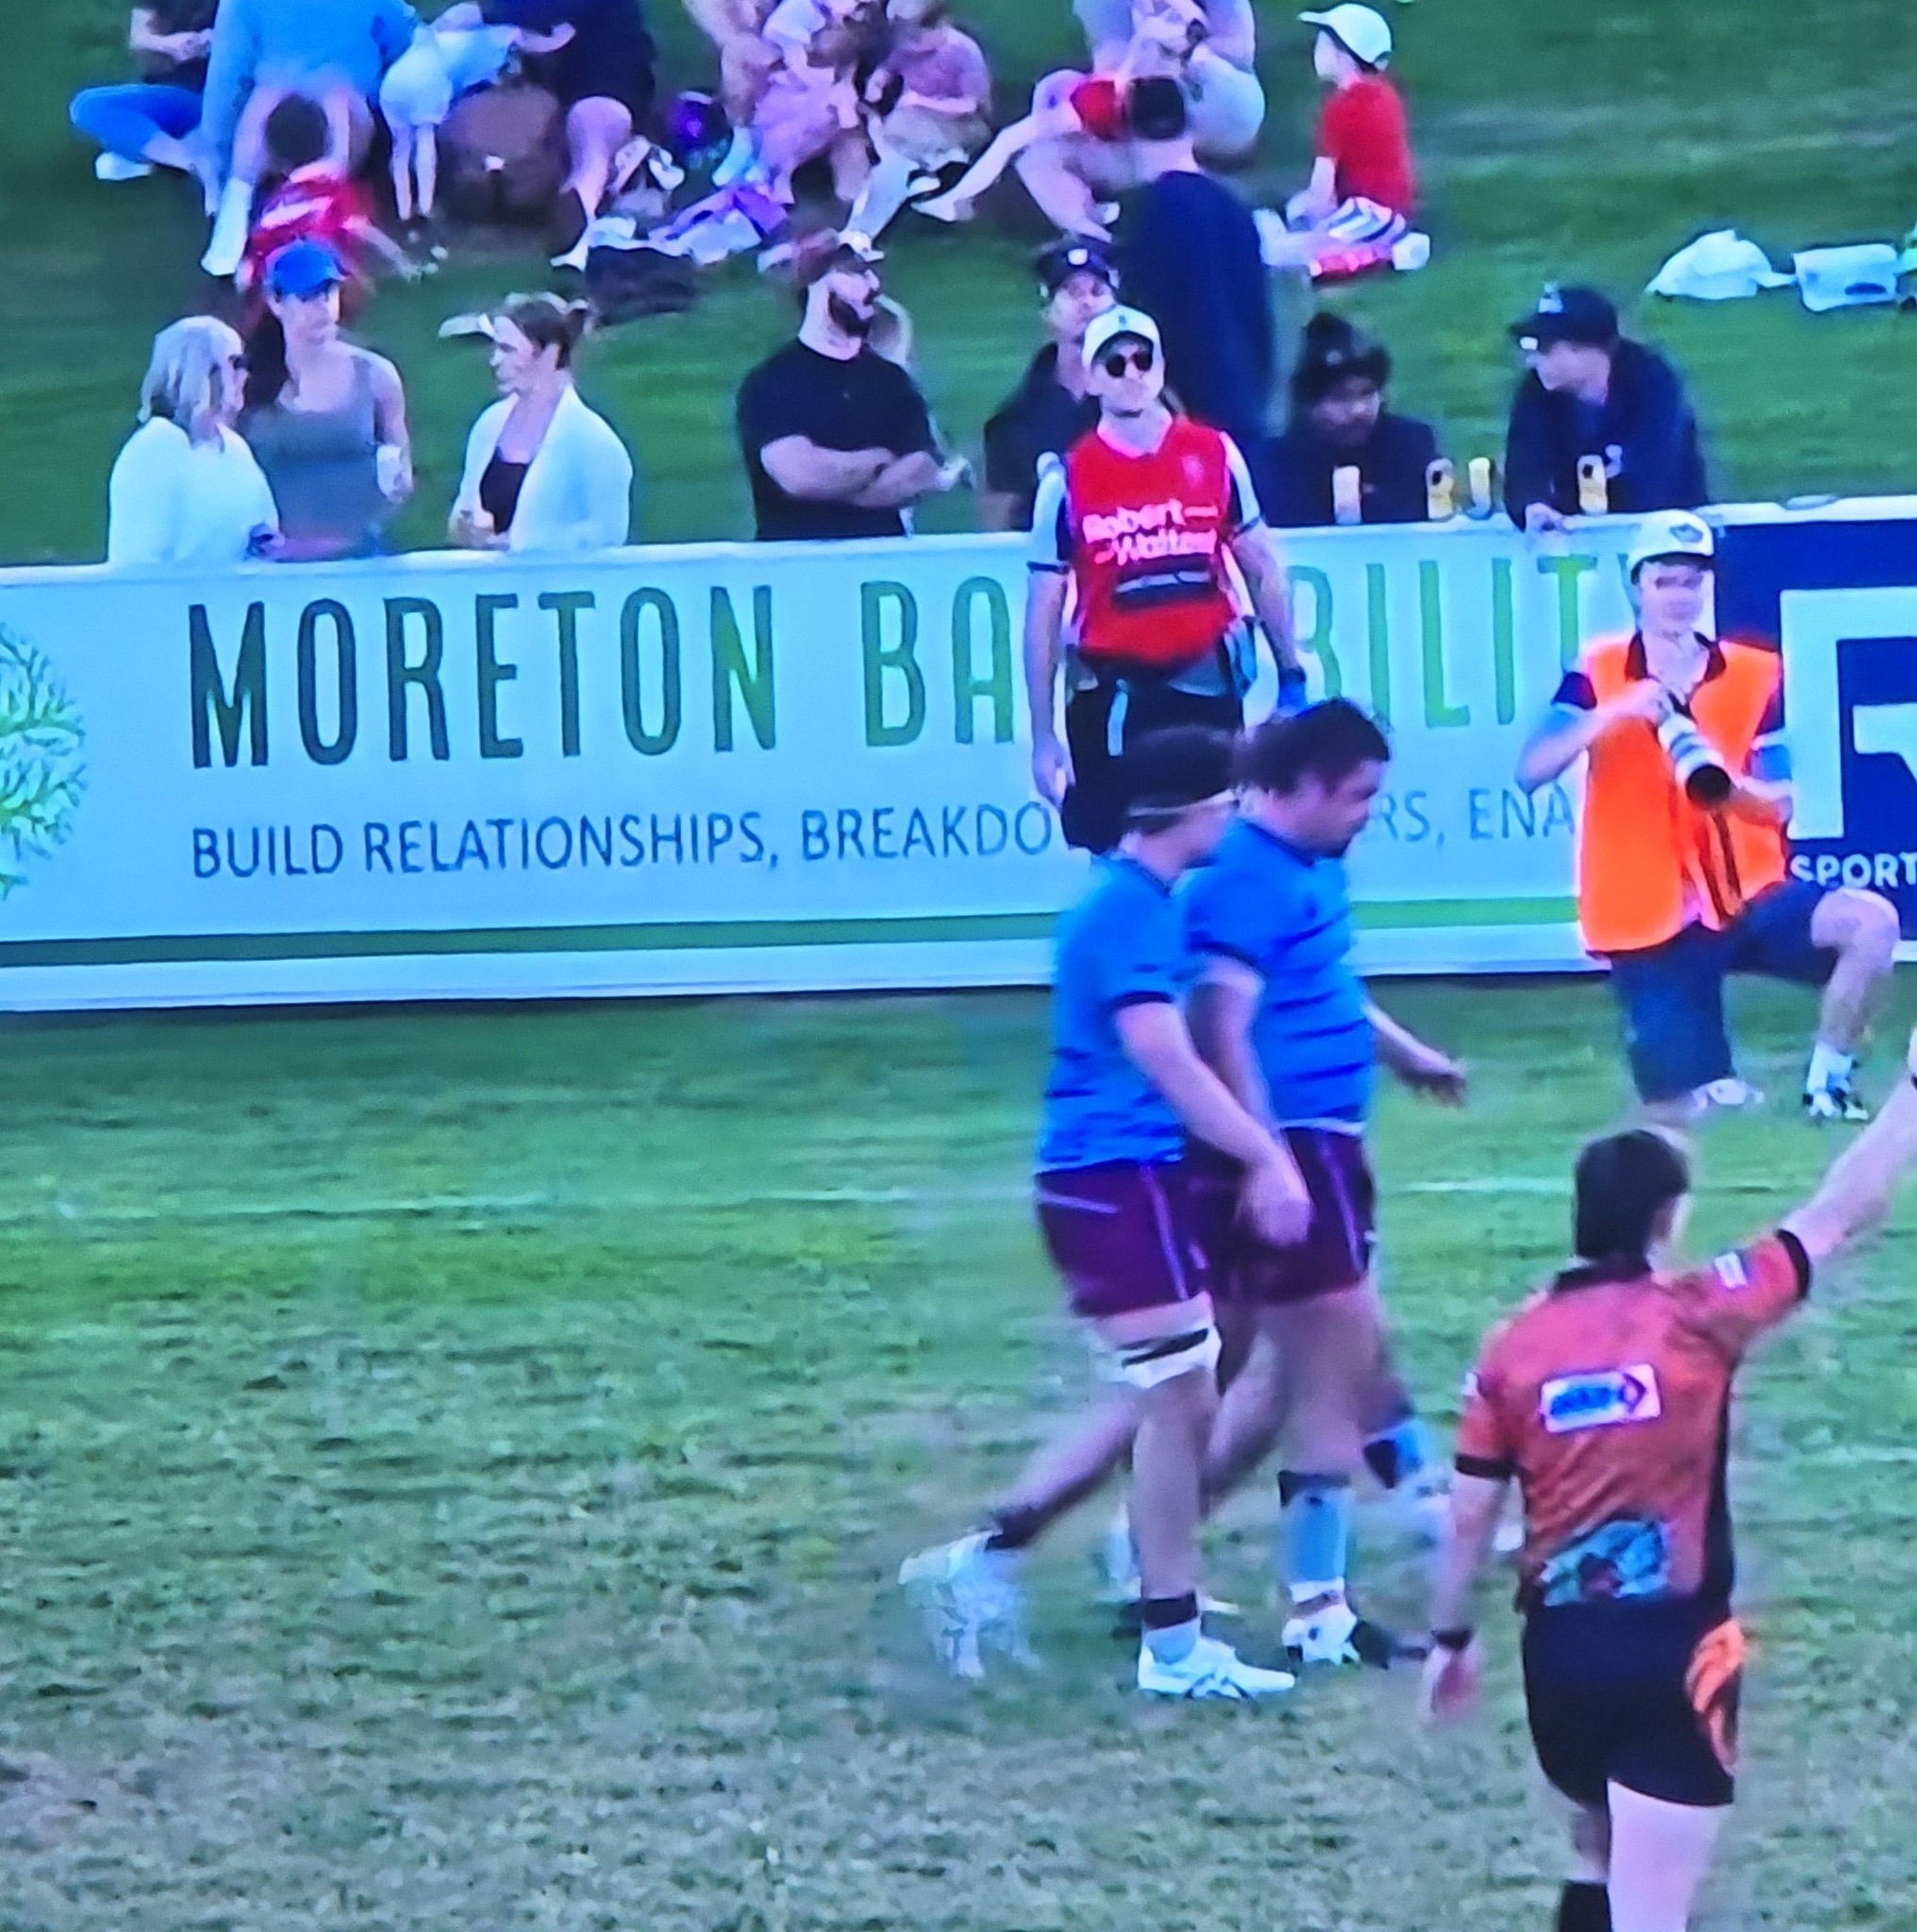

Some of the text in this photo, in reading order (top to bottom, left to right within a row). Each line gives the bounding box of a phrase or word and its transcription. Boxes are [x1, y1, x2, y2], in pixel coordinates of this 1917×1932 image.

[189, 553, 1642, 769] MORETON BA BILIT
[194, 824, 343, 878] BUILD
[365, 812, 780, 874] RELATIONSHIPS,
[802, 801, 1052, 860] BREAKDO
[1468, 780, 1575, 841] ENA
